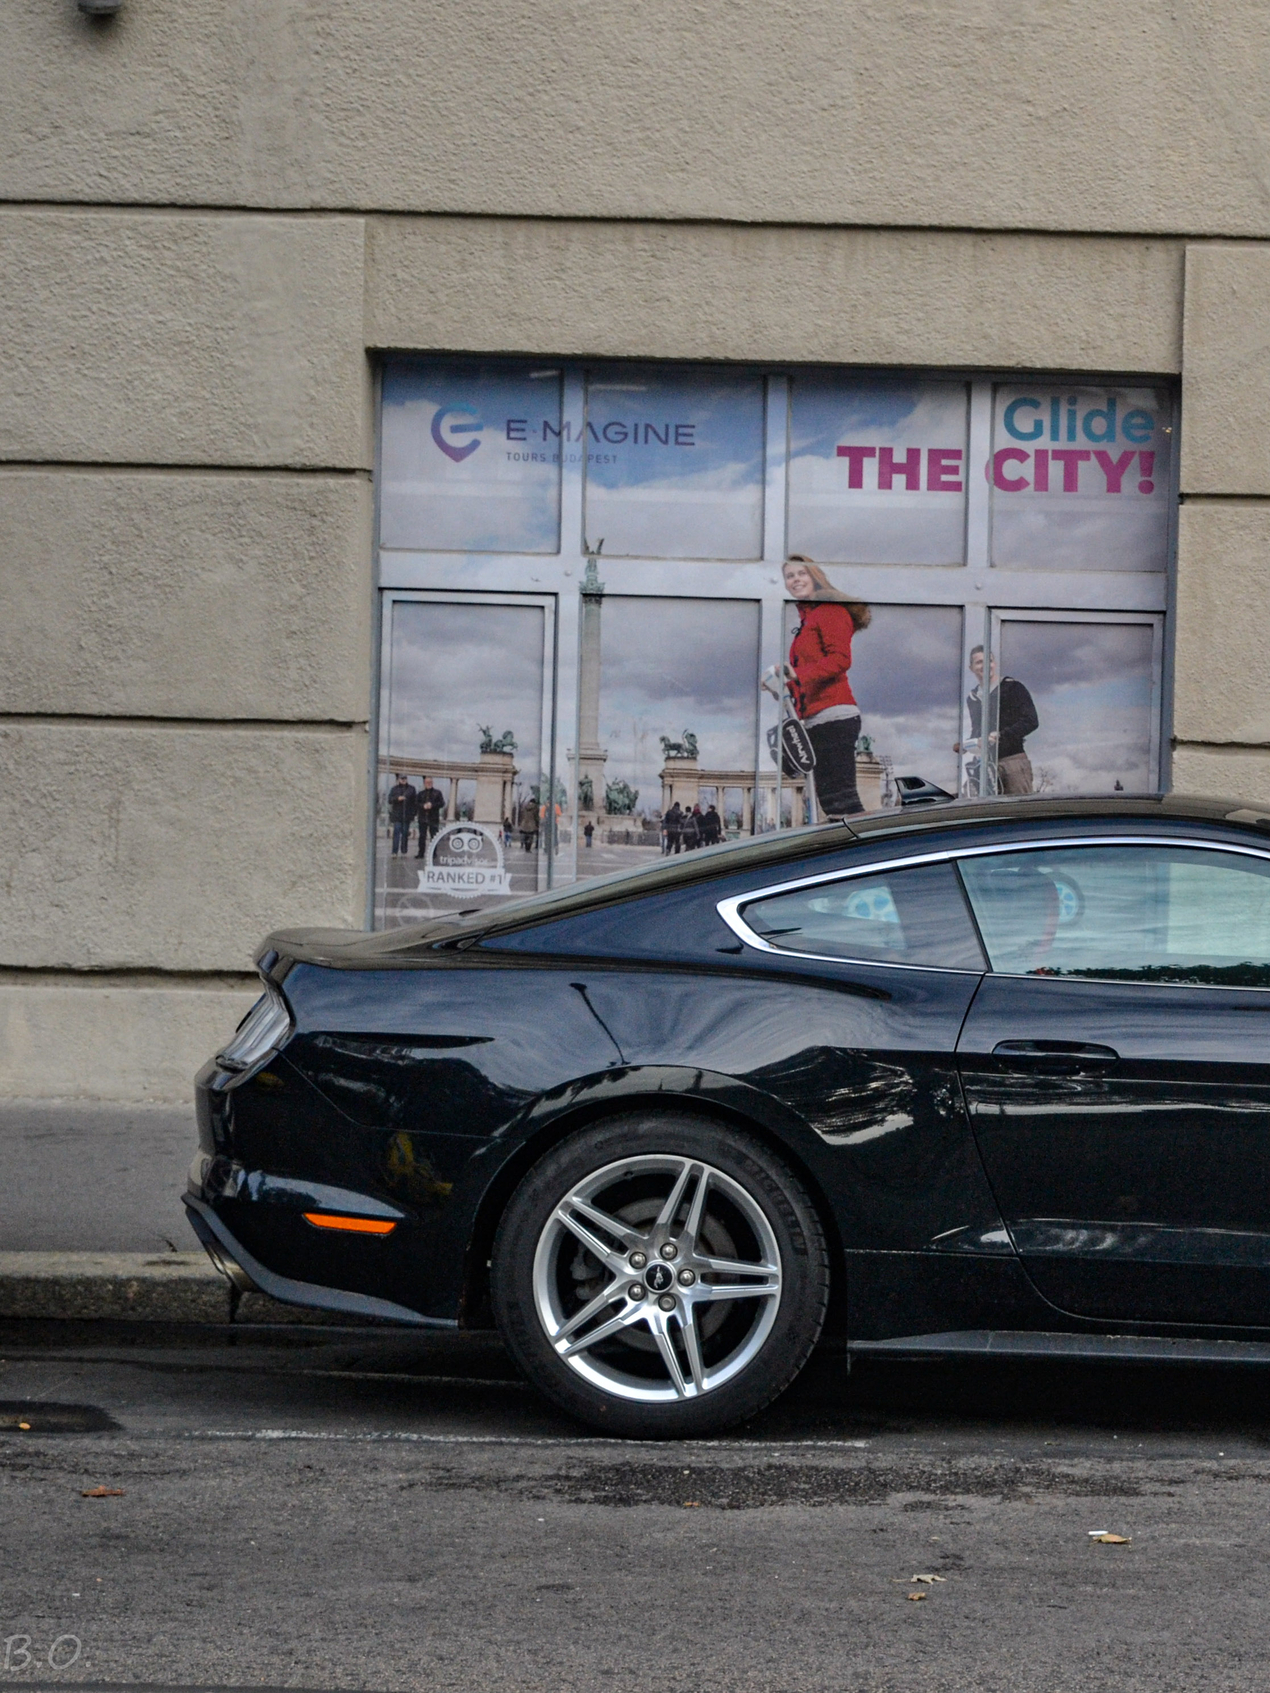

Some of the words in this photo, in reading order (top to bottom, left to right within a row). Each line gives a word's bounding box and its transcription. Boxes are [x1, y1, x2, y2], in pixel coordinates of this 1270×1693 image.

[1003, 396, 1156, 444] Glide
[506, 452, 547, 463] TOURS
[836, 445, 963, 492] THE
[985, 447, 1156, 495] CITY!
[427, 870, 486, 885] RANKED
[489, 874, 502, 885] #1
